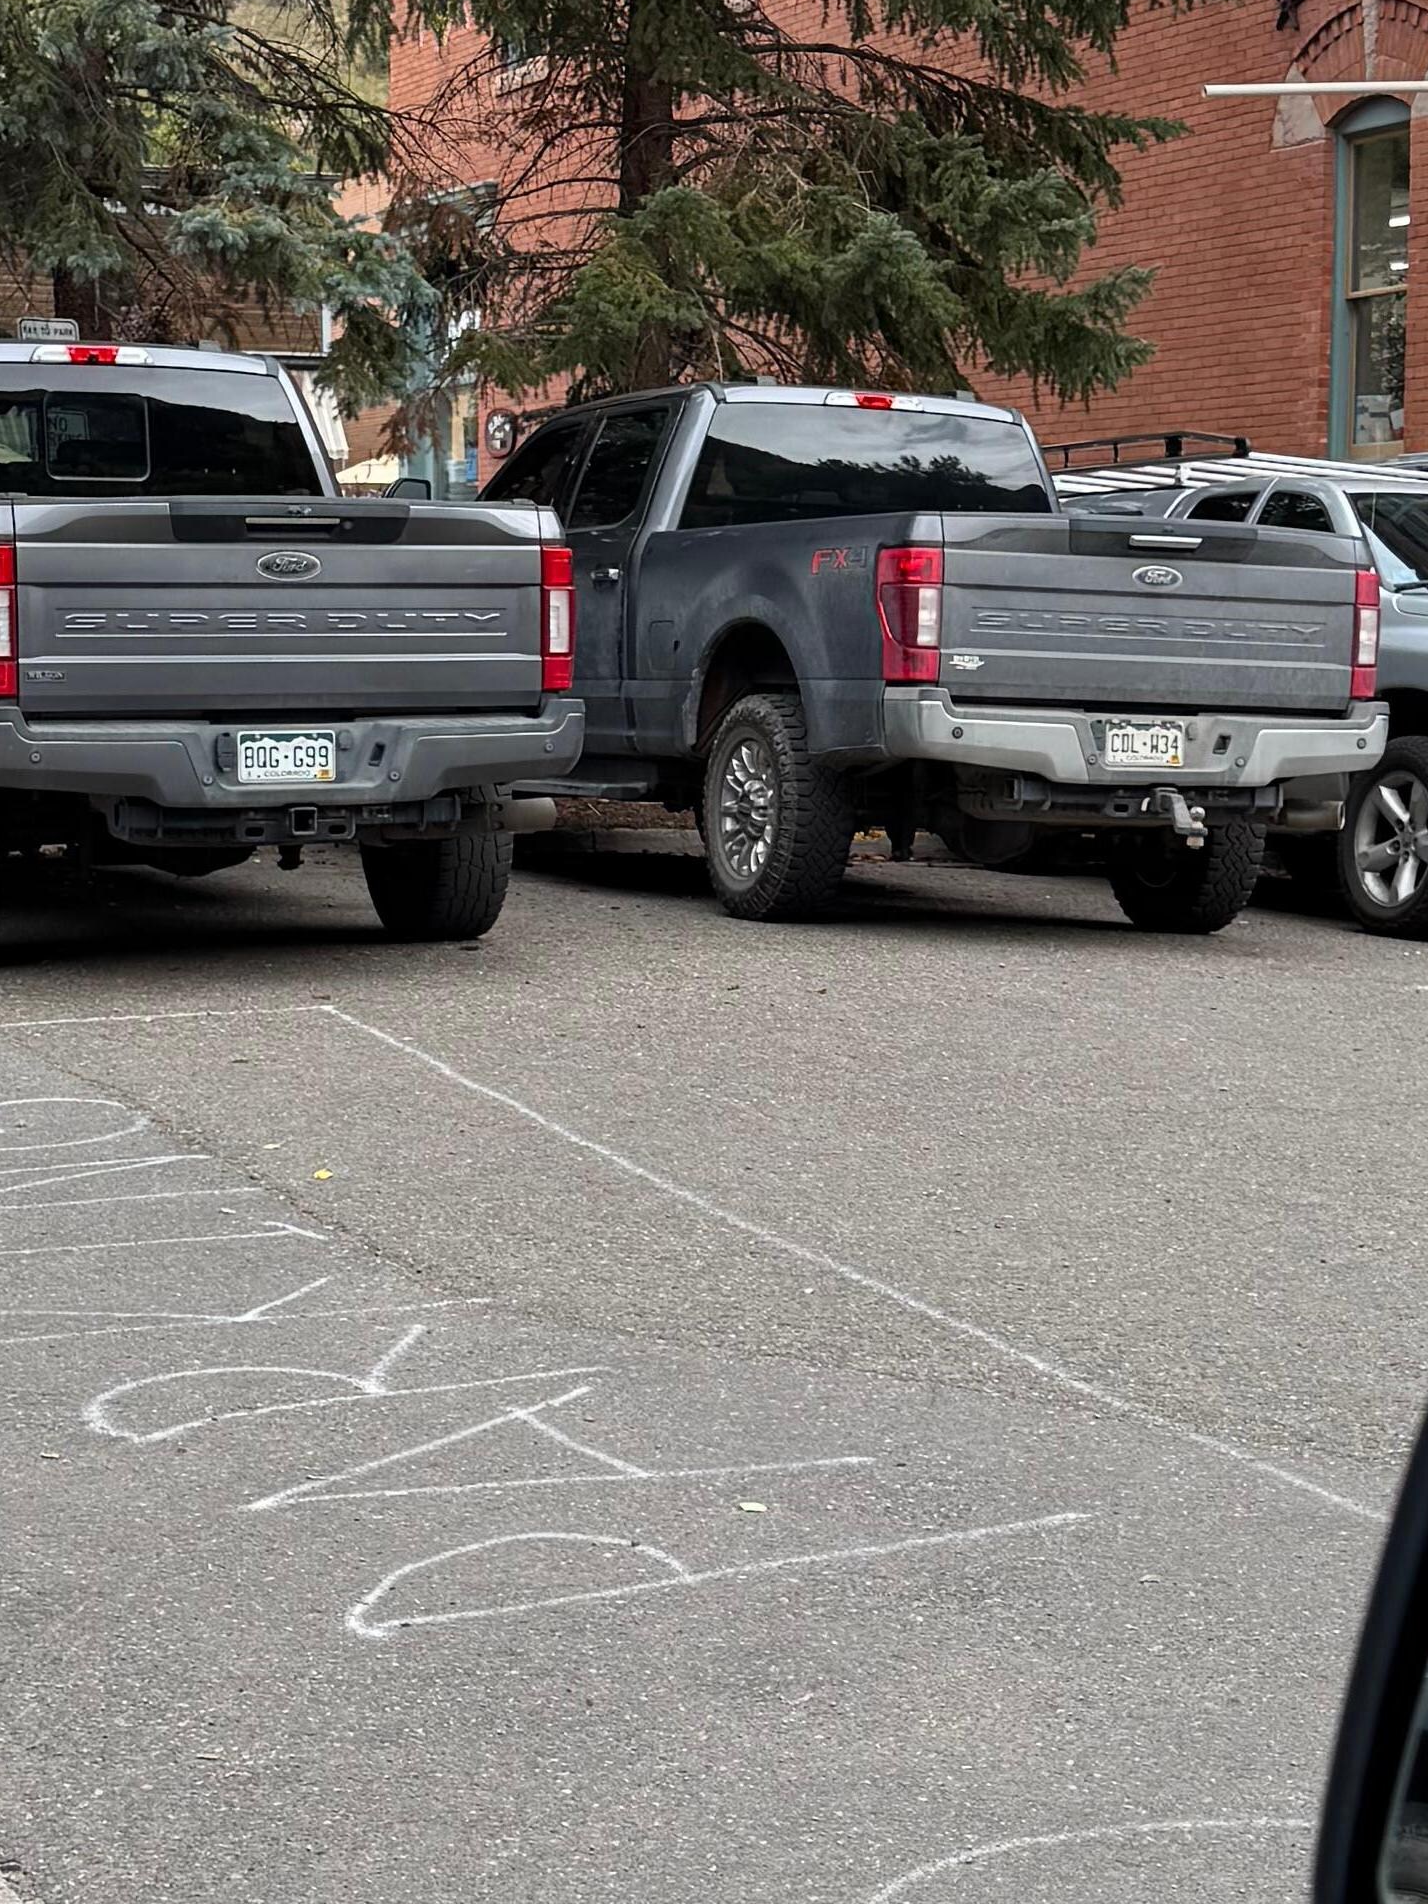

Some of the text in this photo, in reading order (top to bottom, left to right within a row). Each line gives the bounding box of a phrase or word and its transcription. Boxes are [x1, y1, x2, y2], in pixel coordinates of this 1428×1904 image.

[811, 546, 869, 576] FX4
[63, 611, 502, 632] SUPER DUTY
[976, 611, 1322, 641] SUPER DUTY
